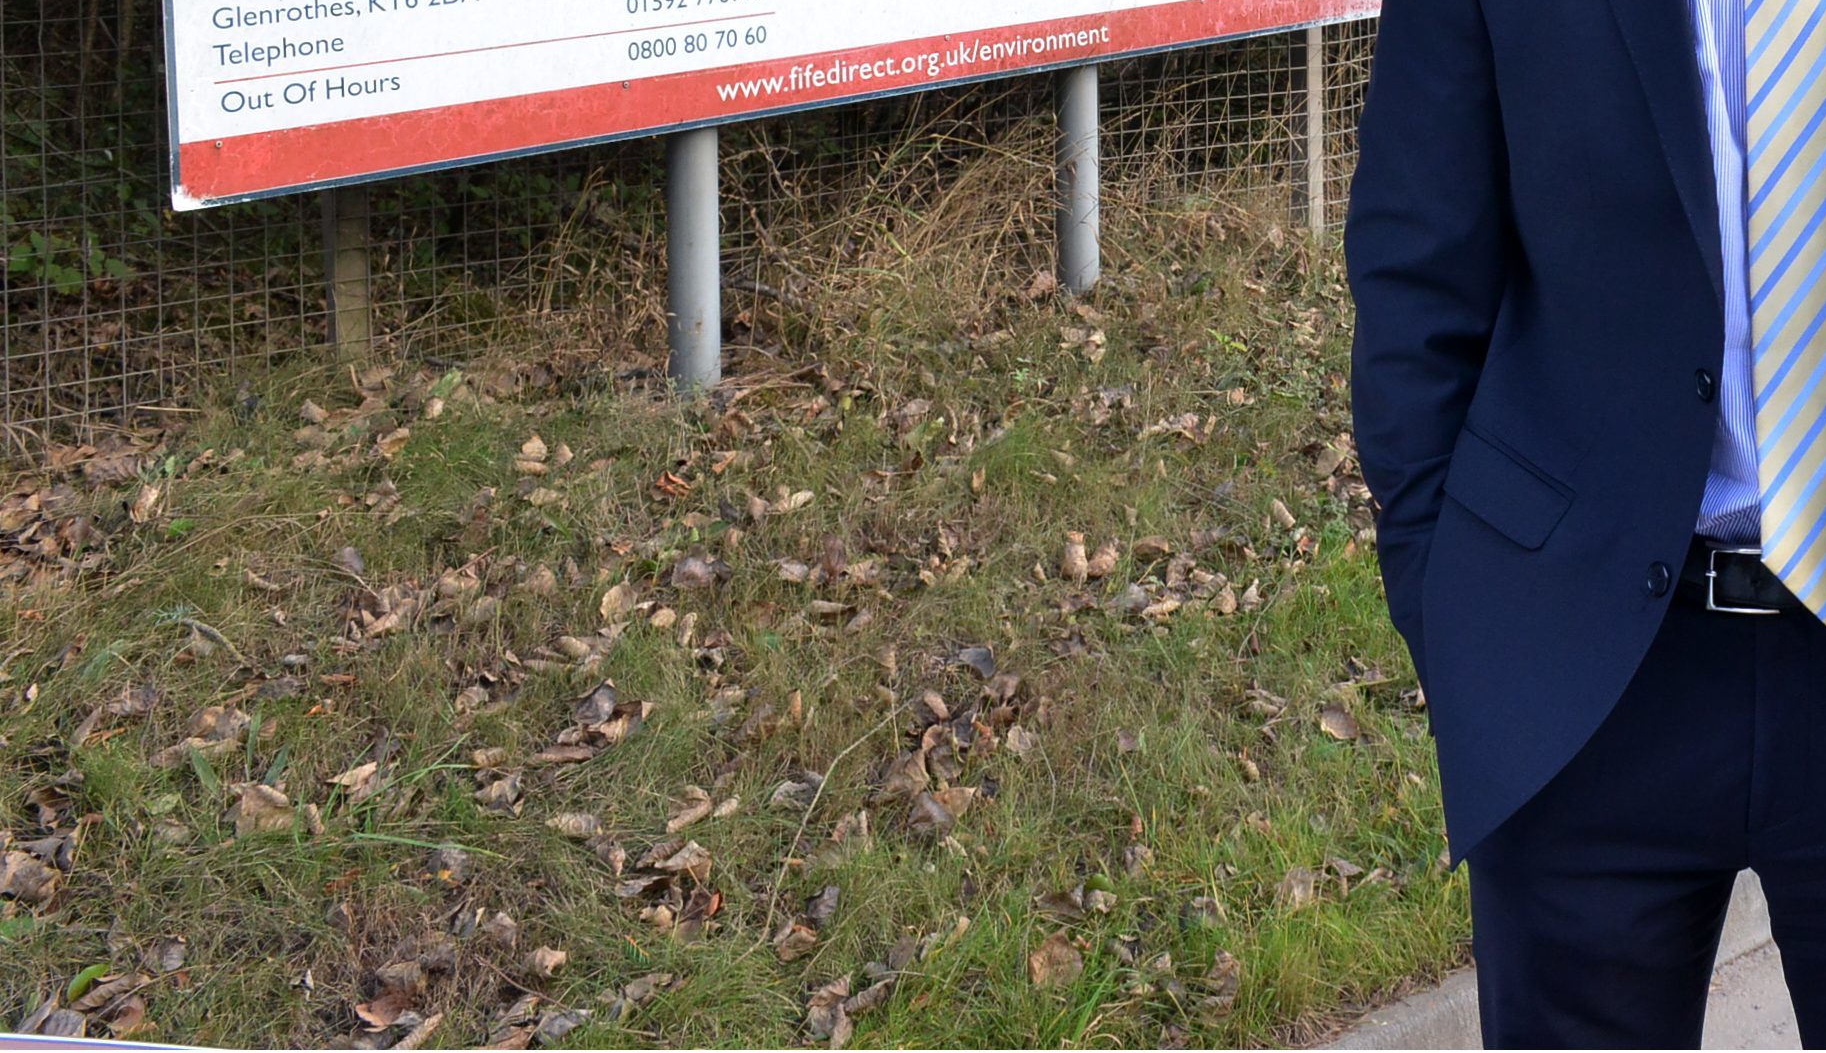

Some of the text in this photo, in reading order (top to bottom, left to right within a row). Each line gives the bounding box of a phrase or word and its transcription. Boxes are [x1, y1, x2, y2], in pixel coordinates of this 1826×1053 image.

[212, 34, 344, 68] Telephone
[628, 25, 767, 62] 0800 80 70 60
[716, 24, 1109, 103] www.fifedirect.org.uk/environment
[221, 72, 401, 114] Out Of Hours
